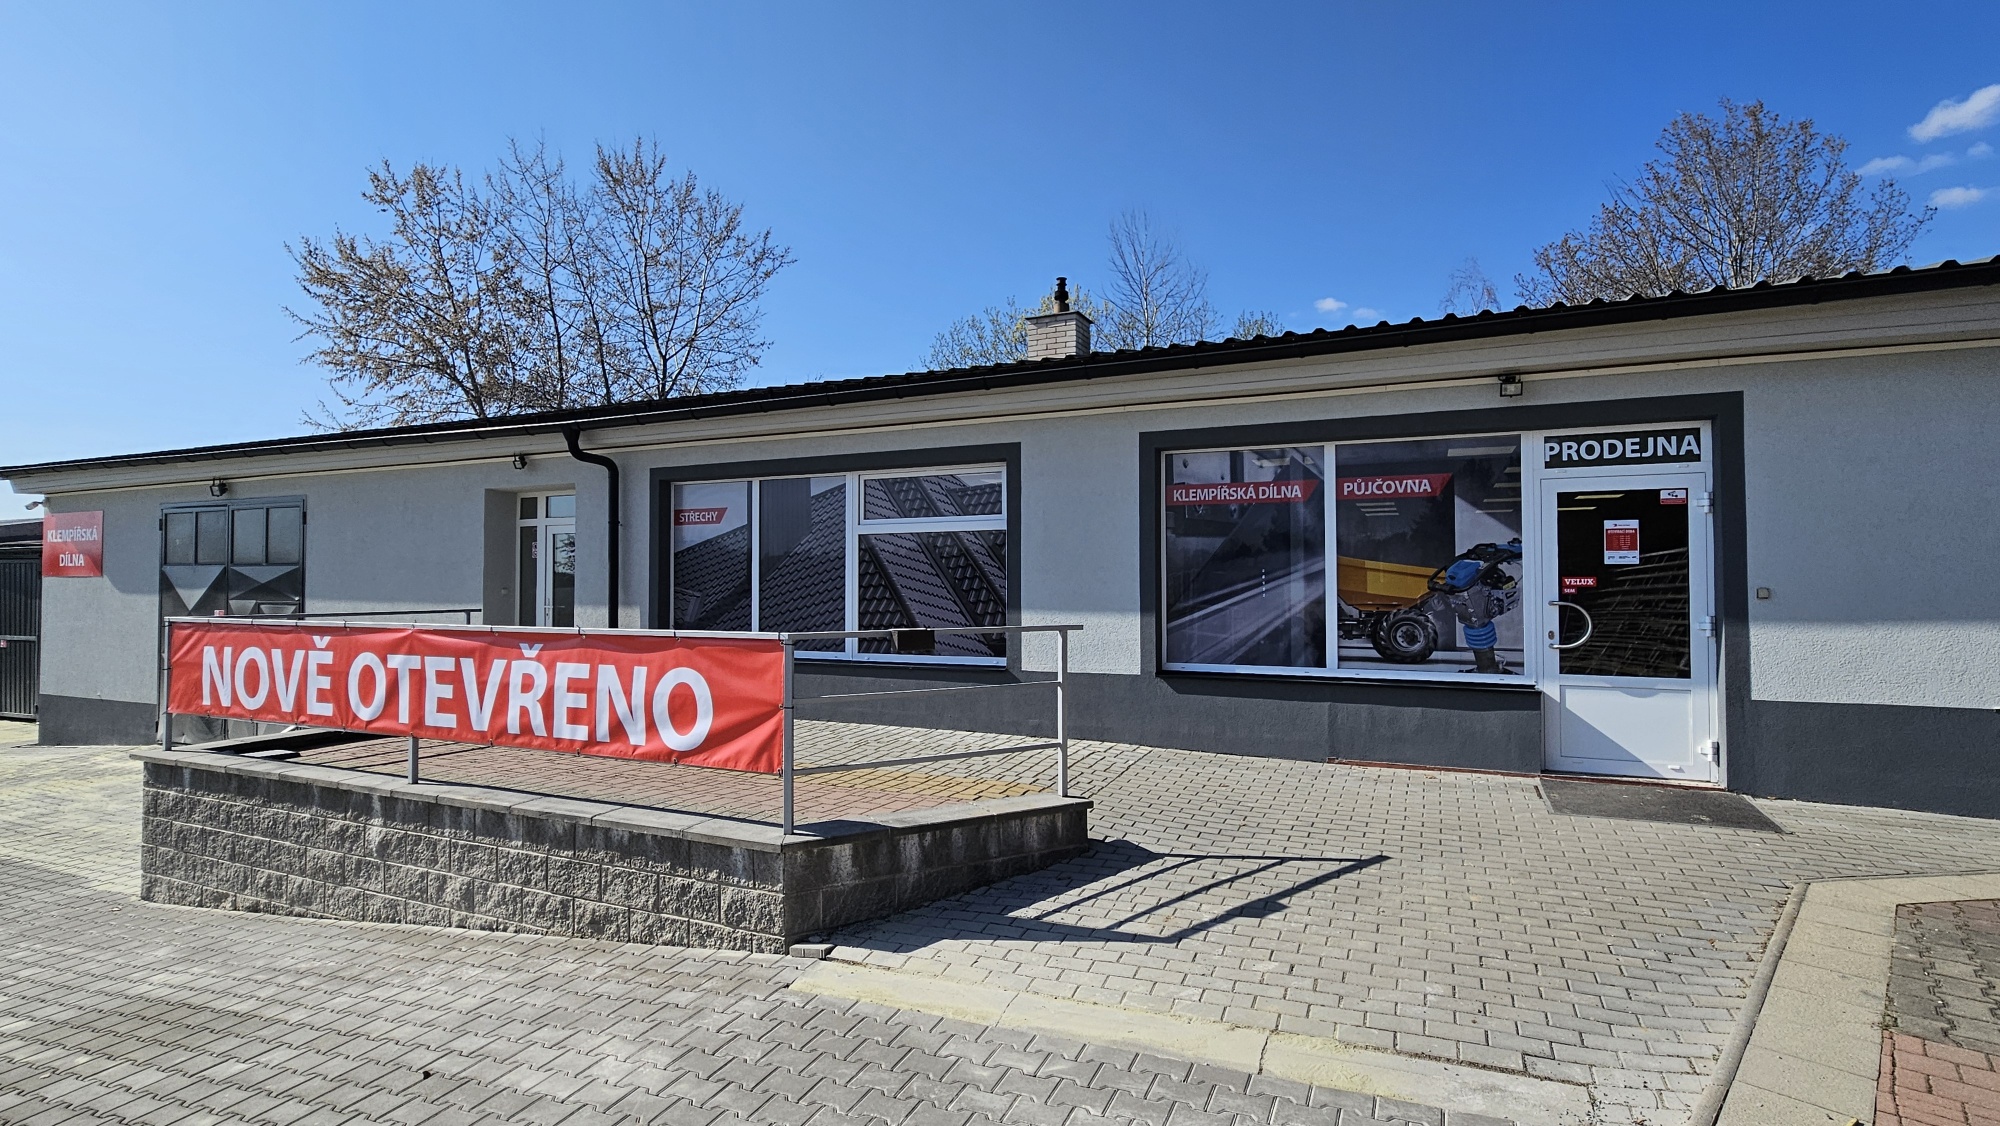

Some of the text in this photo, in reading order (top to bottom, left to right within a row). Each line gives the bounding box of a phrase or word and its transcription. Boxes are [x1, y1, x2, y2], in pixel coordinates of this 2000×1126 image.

[1544, 434, 1701, 462] PRODEJNA
[1173, 483, 1302, 502] KLEMPÍŘSKÁ DÍLNA
[1343, 478, 1432, 496] PŮJČOVNA
[679, 510, 718, 523] STŘECHY
[47, 525, 98, 543] KLEMPÍŘSKÁ
[59, 551, 85, 567] DÍLNA
[1564, 578, 1594, 586] VELUX
[202, 635, 713, 752] NOVĚ OTEVŘENO
